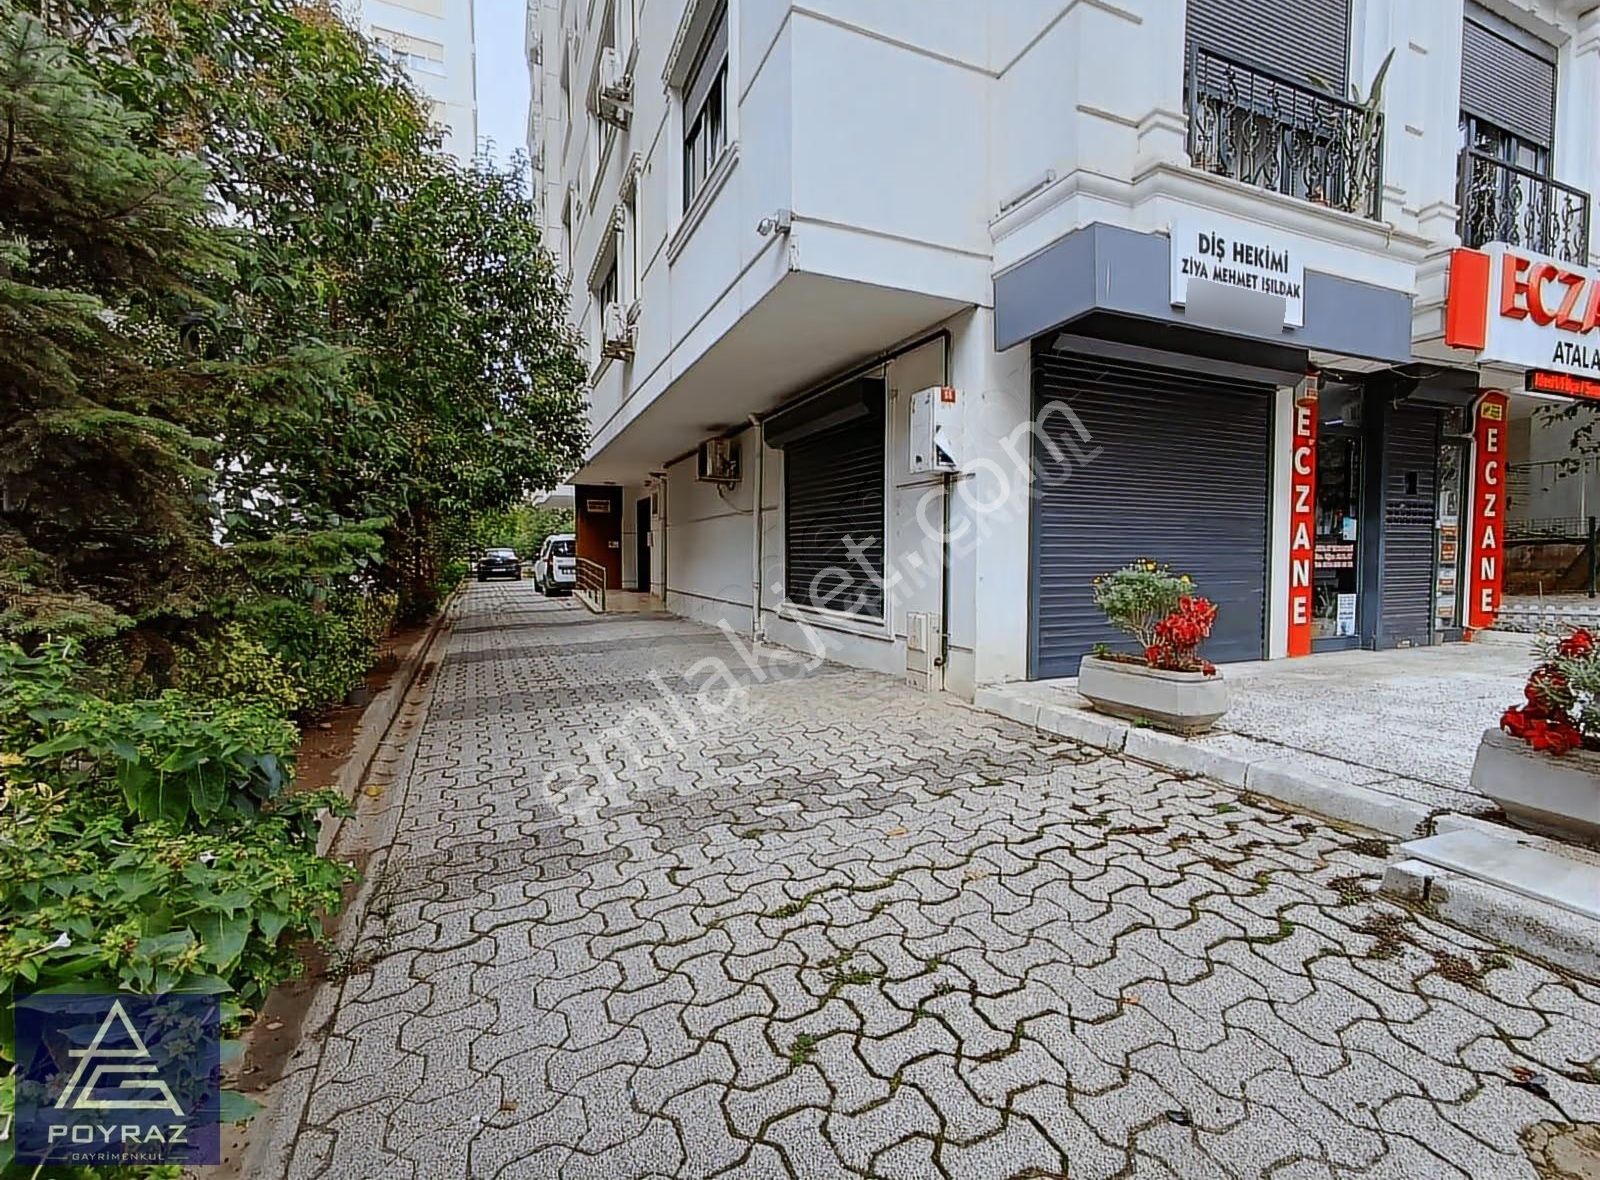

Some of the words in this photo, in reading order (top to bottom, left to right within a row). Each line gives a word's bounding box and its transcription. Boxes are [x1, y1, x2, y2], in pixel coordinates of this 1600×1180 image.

[1181, 256, 1208, 279] ZİYA
[1212, 265, 1258, 290] MEHMET
[1261, 276, 1301, 299] IŞILDAK
[1198, 231, 1225, 262] DİŞ
[1233, 245, 1288, 274] HEKİMİ
[1293, 408, 1311, 624] ECZANE
[1481, 428, 1498, 612] ECZANE
